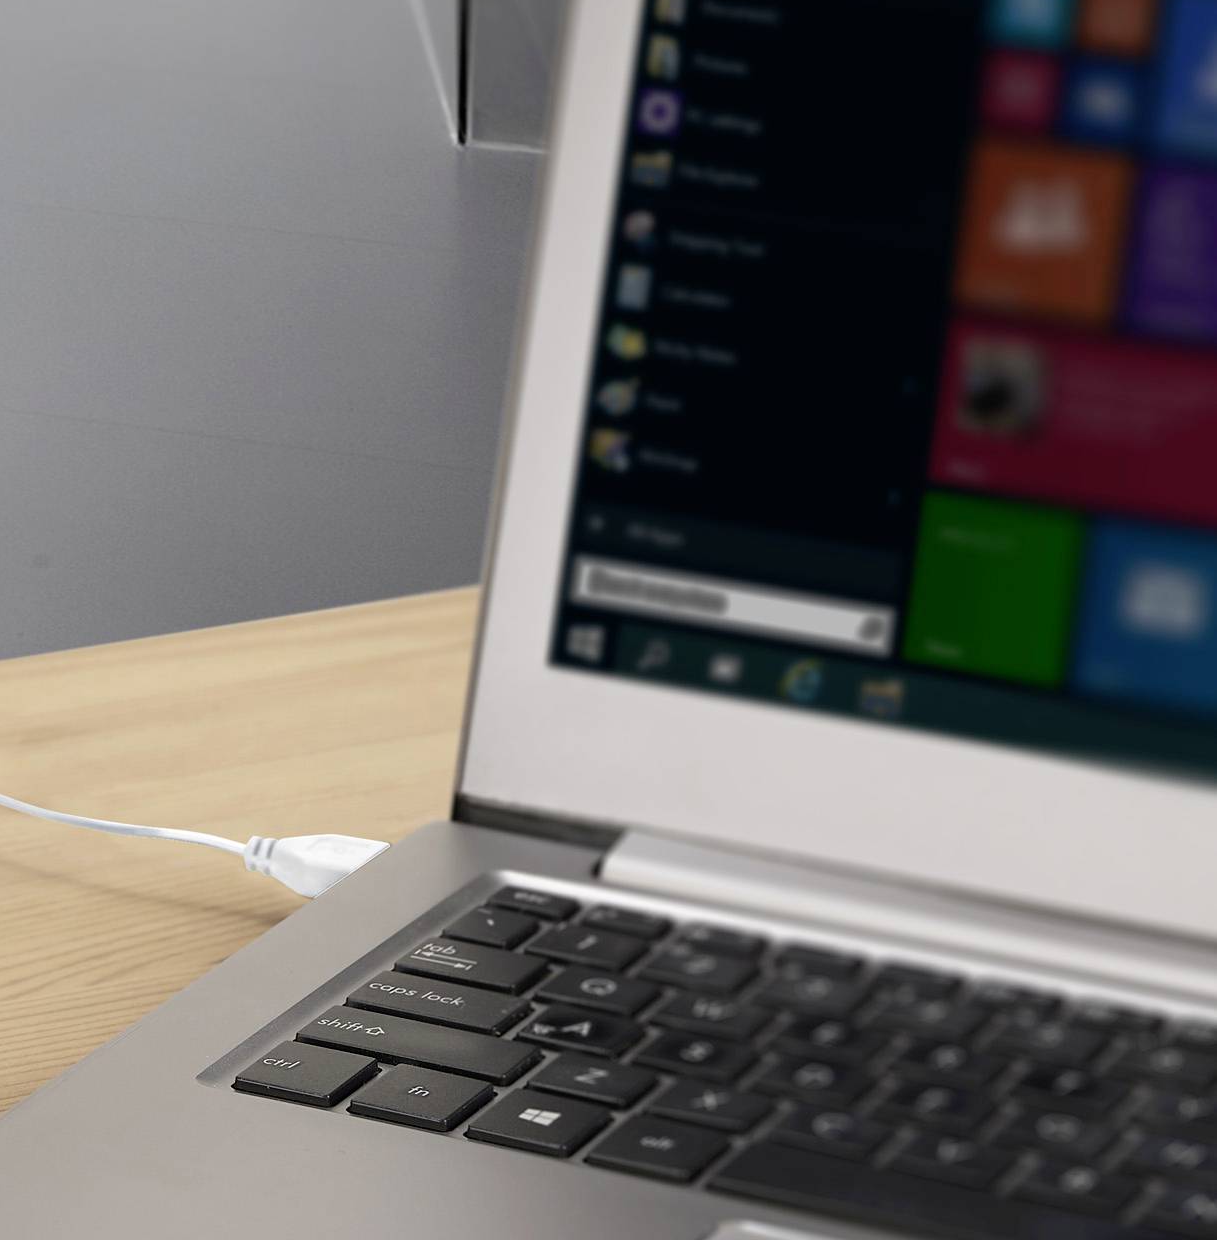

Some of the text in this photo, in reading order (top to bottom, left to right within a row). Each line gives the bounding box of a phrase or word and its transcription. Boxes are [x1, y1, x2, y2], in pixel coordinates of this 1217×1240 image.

[423, 943, 457, 955] tab
[369, 981, 464, 1006] caps lock
[317, 1018, 364, 1032] shift
[263, 1057, 301, 1070] ctrl
[407, 1085, 430, 1098] fn
